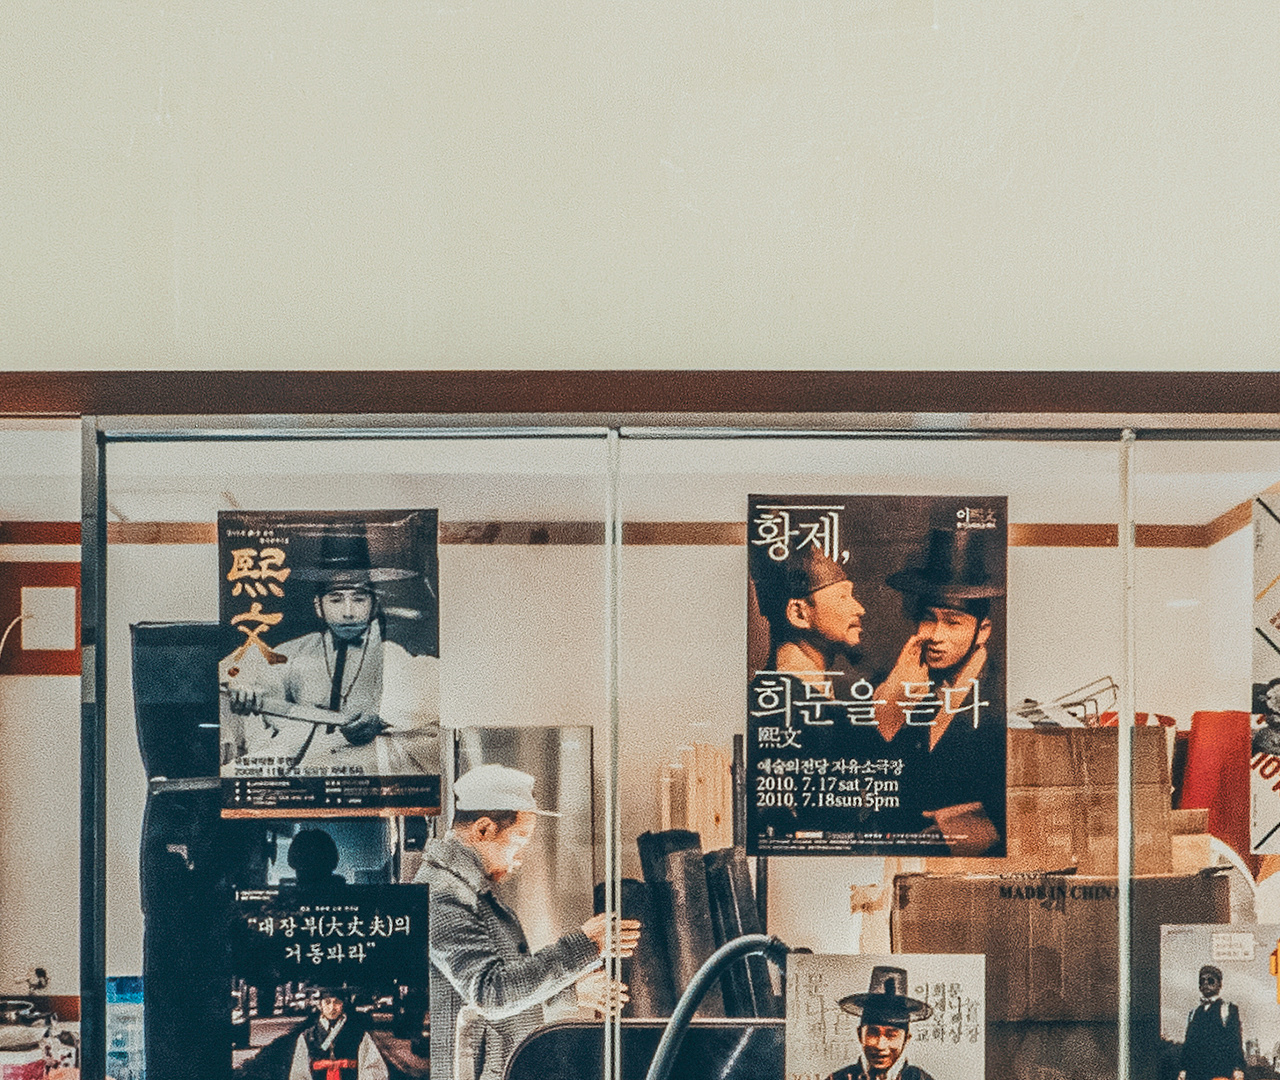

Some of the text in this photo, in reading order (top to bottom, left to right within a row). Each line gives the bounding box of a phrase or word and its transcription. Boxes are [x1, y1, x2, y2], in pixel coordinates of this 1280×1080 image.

[751, 511, 850, 565] 황제,
[750, 677, 990, 730] 희문을 듣다
[756, 757, 906, 776] 예술의전당 자유소극장
[756, 776, 798, 791] 2010.
[802, 776, 816, 791] 7.
[864, 776, 900, 796] 7pm
[756, 792, 798, 807] 2010.
[865, 792, 900, 812] 5pm
[1000, 885, 1046, 900] MADE
[1049, 885, 1066, 900] IN
